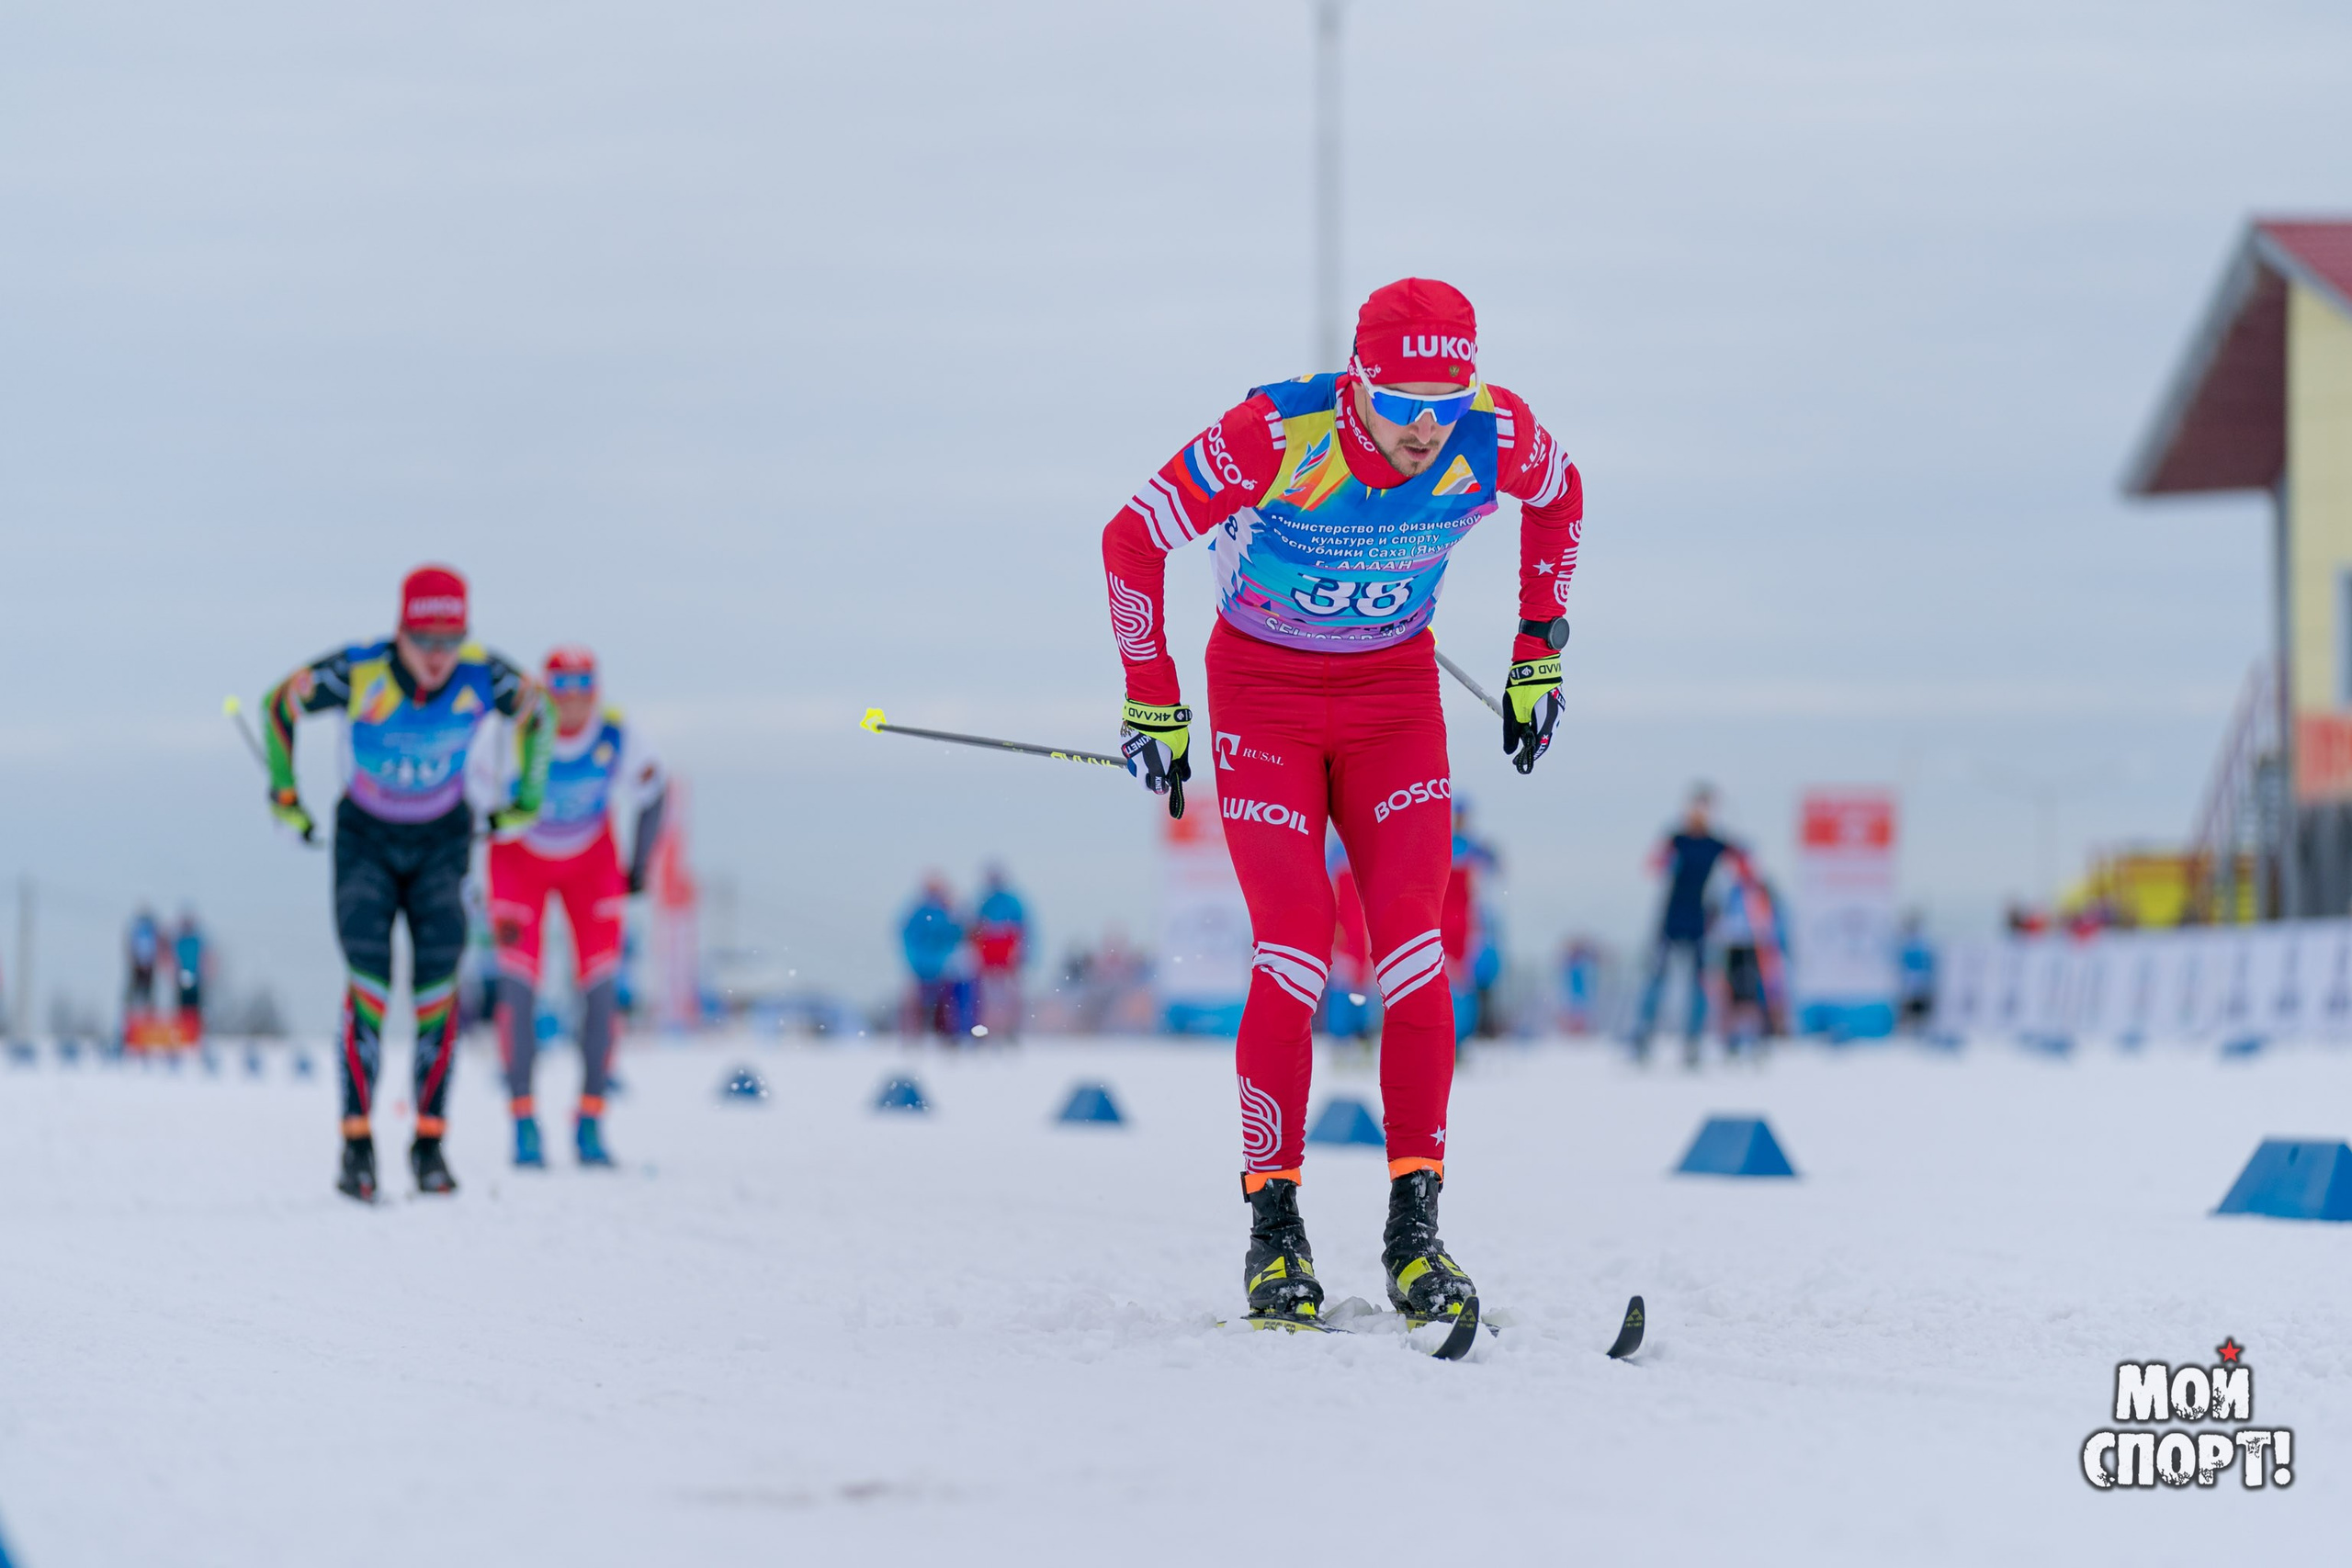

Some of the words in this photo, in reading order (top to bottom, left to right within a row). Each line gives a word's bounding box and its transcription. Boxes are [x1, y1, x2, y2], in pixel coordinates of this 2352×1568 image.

[1208, 418, 1242, 484] OSCO
[1378, 524, 1395, 534] по
[1399, 512, 1481, 533] физической
[1311, 535, 1374, 547] культуре
[1379, 536, 1387, 545] и
[1391, 534, 1440, 546] спорту
[1368, 547, 1407, 558] Саха
[1337, 559, 1414, 570] АЛДАН
[1291, 572, 1418, 616] 38
[1243, 748, 1283, 766] RUSAL
[1374, 777, 1451, 823] BOSCO
[1223, 796, 1309, 835] LUKOIL
